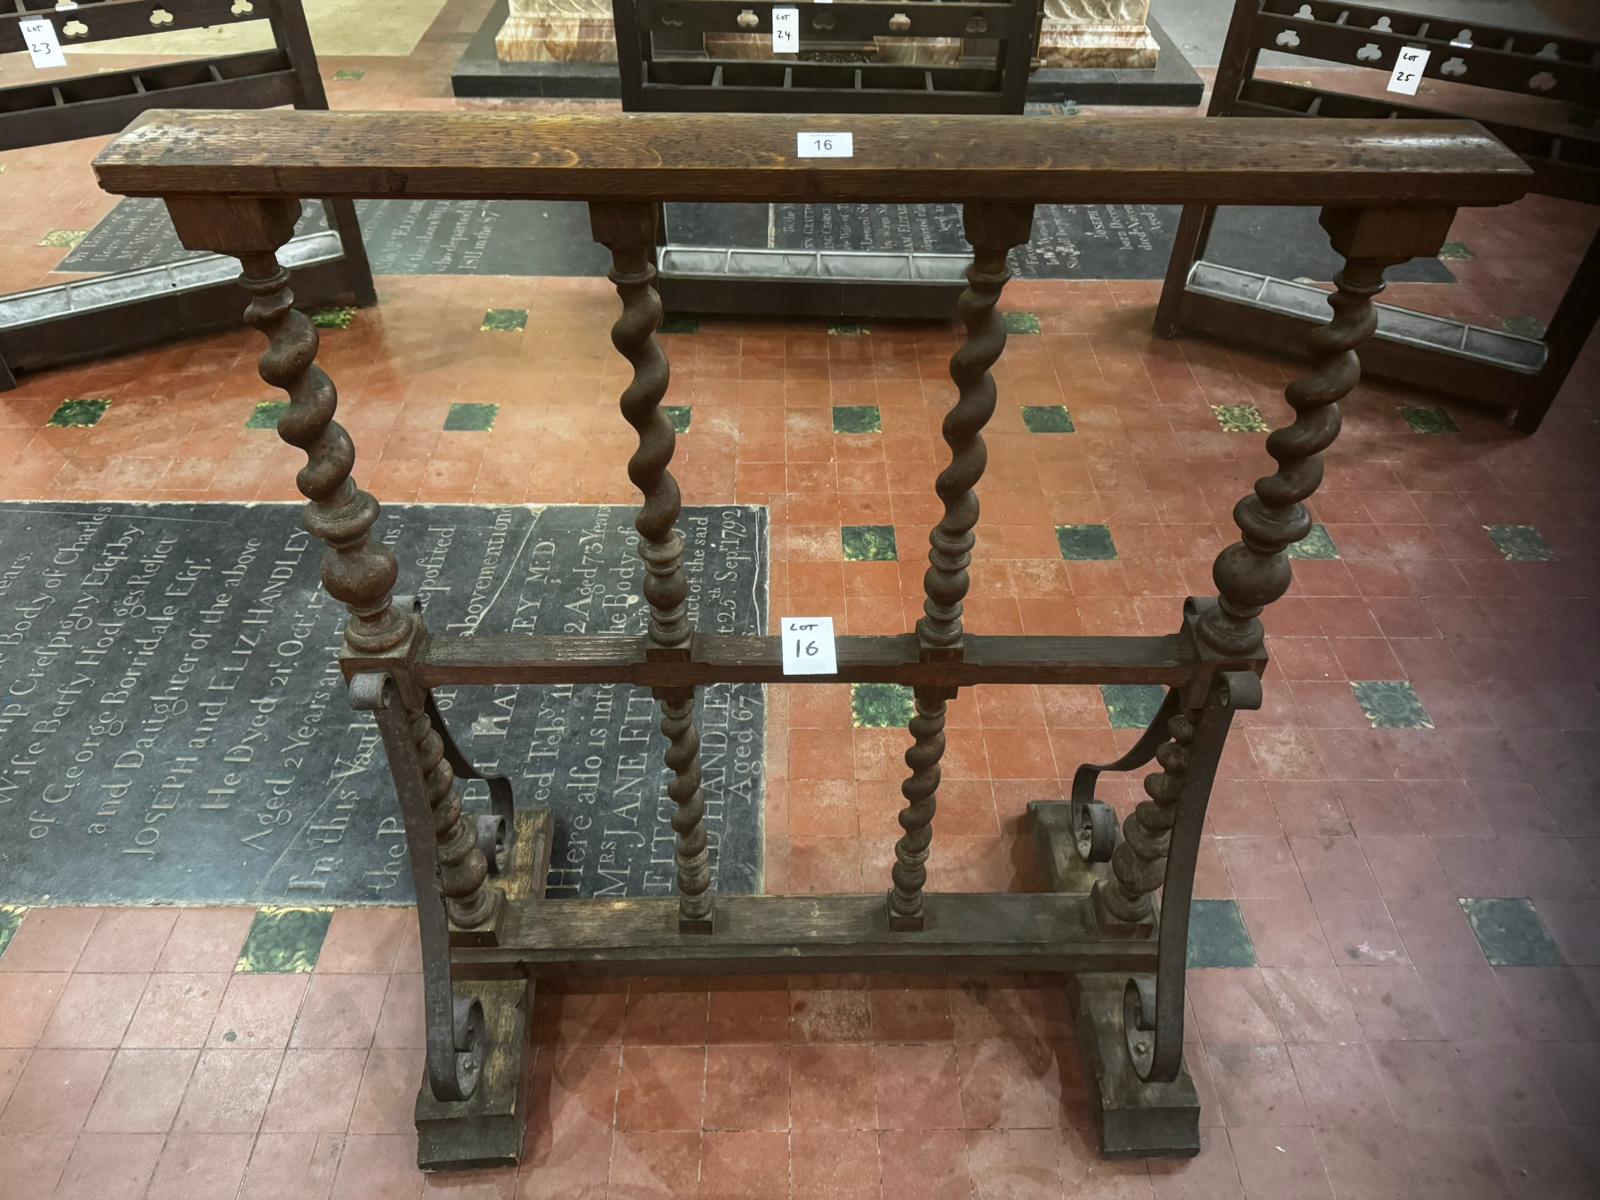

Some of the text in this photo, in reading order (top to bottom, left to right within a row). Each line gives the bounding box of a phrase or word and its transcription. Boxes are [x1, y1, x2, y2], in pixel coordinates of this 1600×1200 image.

[31, 42, 51, 54] 23
[777, 30, 791, 41] 24
[1397, 71, 1415, 81] 25
[1403, 53, 1419, 62] LOT
[813, 139, 833, 151] 16
[52, 507, 113, 565] Charles
[688, 516, 709, 546] said
[720, 509, 748, 546] 1792
[0, 551, 34, 596] ears.
[126, 535, 179, 585] Relict
[581, 542, 605, 566] 73
[684, 549, 706, 574] the
[41, 567, 68, 589] of
[563, 566, 606, 622] Aged
[606, 551, 644, 602] Body
[0, 594, 56, 645] Body
[597, 613, 628, 635] he
[789, 623, 819, 631] LOT
[795, 639, 819, 658] 16
[87, 537, 262, 834] and Daughter of the above
[121, 756, 199, 861] JOSEPH
[188, 701, 228, 749] and
[242, 526, 312, 625] HANDLEY
[279, 691, 331, 753] Years
[731, 694, 765, 721] 67
[199, 772, 243, 809] He
[223, 696, 287, 763] Dyed
[587, 727, 608, 746] is
[42, 710, 128, 804] George
[283, 757, 304, 769] 2
[727, 728, 765, 805] Aged
[240, 777, 304, 853] Aged
[306, 789, 361, 848] this
[605, 753, 645, 849] JANE
[28, 810, 57, 839] of
[367, 843, 408, 890] the
[544, 814, 593, 892] Here
[286, 855, 338, 895] In
